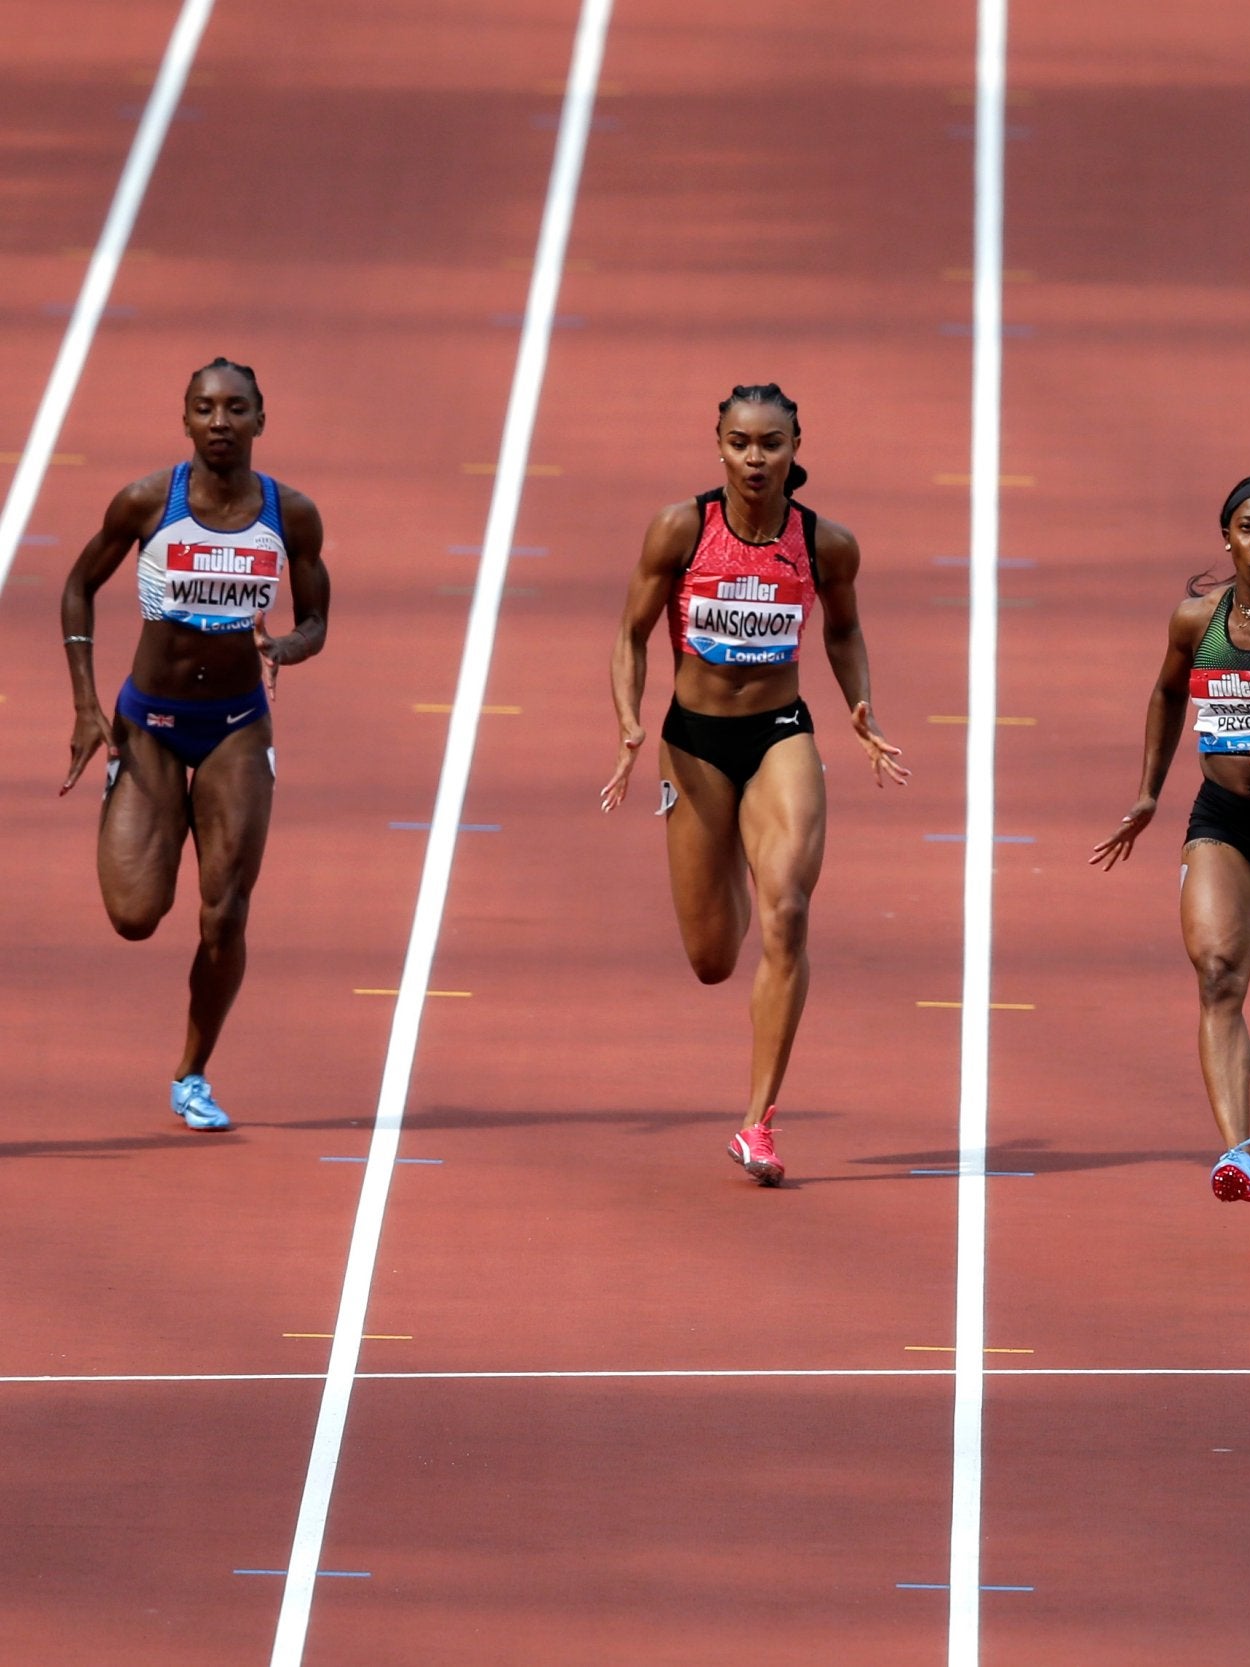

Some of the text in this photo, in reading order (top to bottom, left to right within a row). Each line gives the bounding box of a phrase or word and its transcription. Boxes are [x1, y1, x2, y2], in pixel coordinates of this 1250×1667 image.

[193, 547, 255, 573] müller
[172, 580, 271, 608] WILLIAMS
[717, 576, 779, 601] müller
[695, 606, 795, 638] LANSIQUOT
